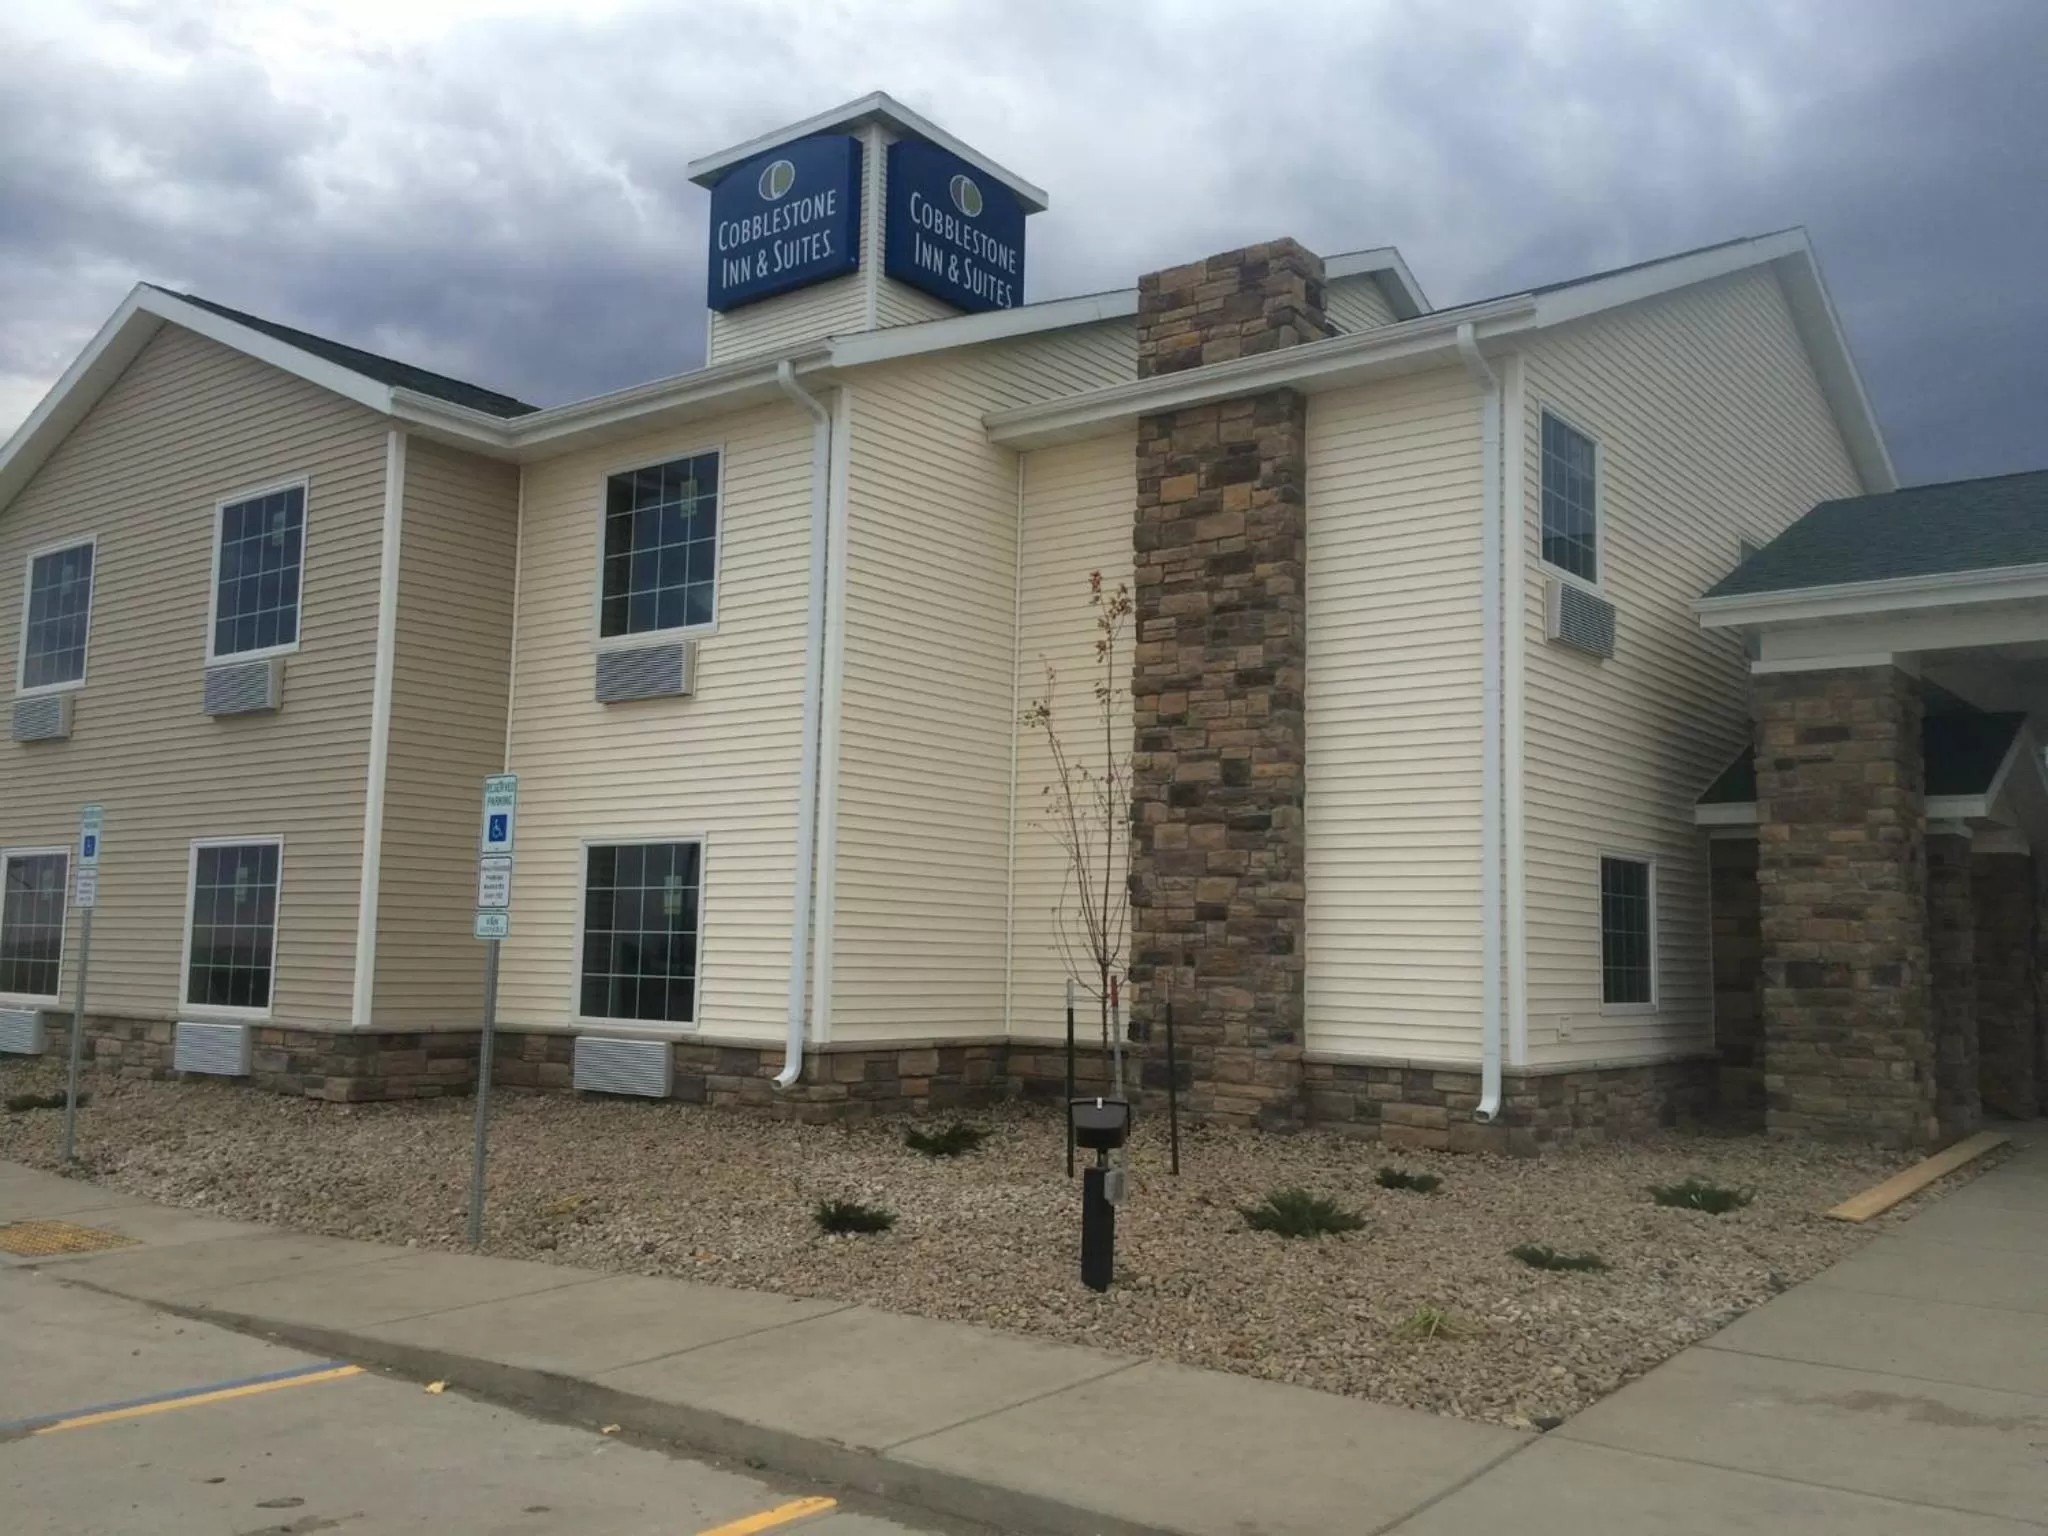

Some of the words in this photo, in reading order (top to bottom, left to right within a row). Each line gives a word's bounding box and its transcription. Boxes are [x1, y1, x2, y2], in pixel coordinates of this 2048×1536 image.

[718, 188, 837, 252] COBBLESTONE
[910, 191, 1016, 275] COBBLESTONE
[721, 254, 751, 290] INN
[756, 250, 769, 279] &
[773, 229, 832, 275] SUITES
[915, 231, 943, 277] INN
[948, 254, 959, 284] &
[963, 257, 1013, 309] SUITES
